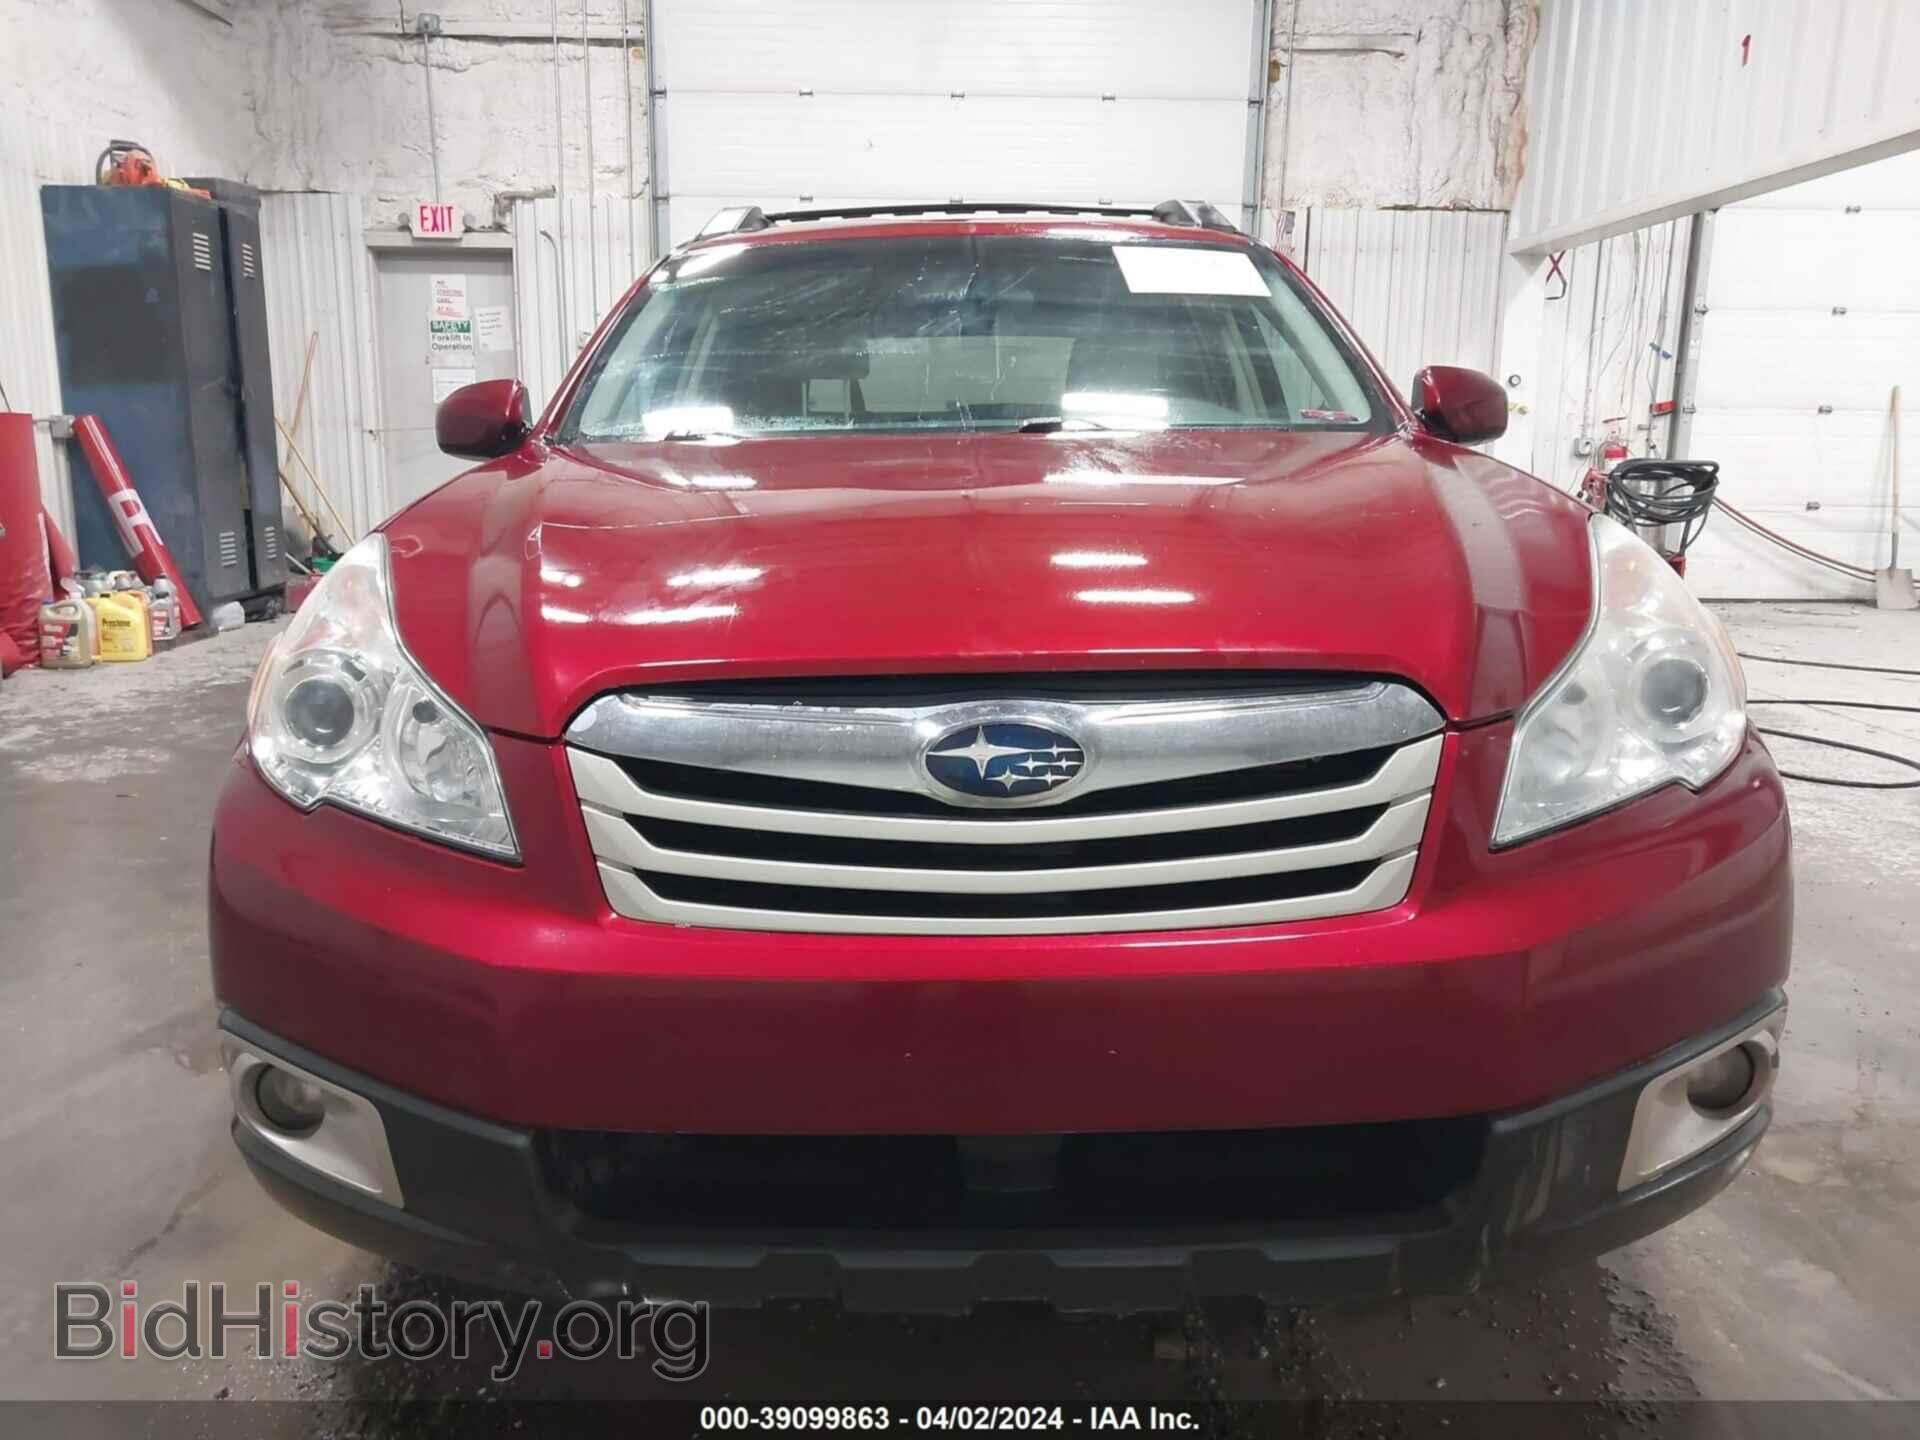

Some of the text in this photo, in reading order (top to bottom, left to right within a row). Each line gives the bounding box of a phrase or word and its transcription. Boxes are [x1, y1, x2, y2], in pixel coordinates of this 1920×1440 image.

[1741, 34, 1752, 68] 1
[419, 205, 454, 233] EXIT
[433, 321, 469, 329] SAFETY
[432, 333, 461, 342] Forklift
[432, 342, 472, 352] Operation
